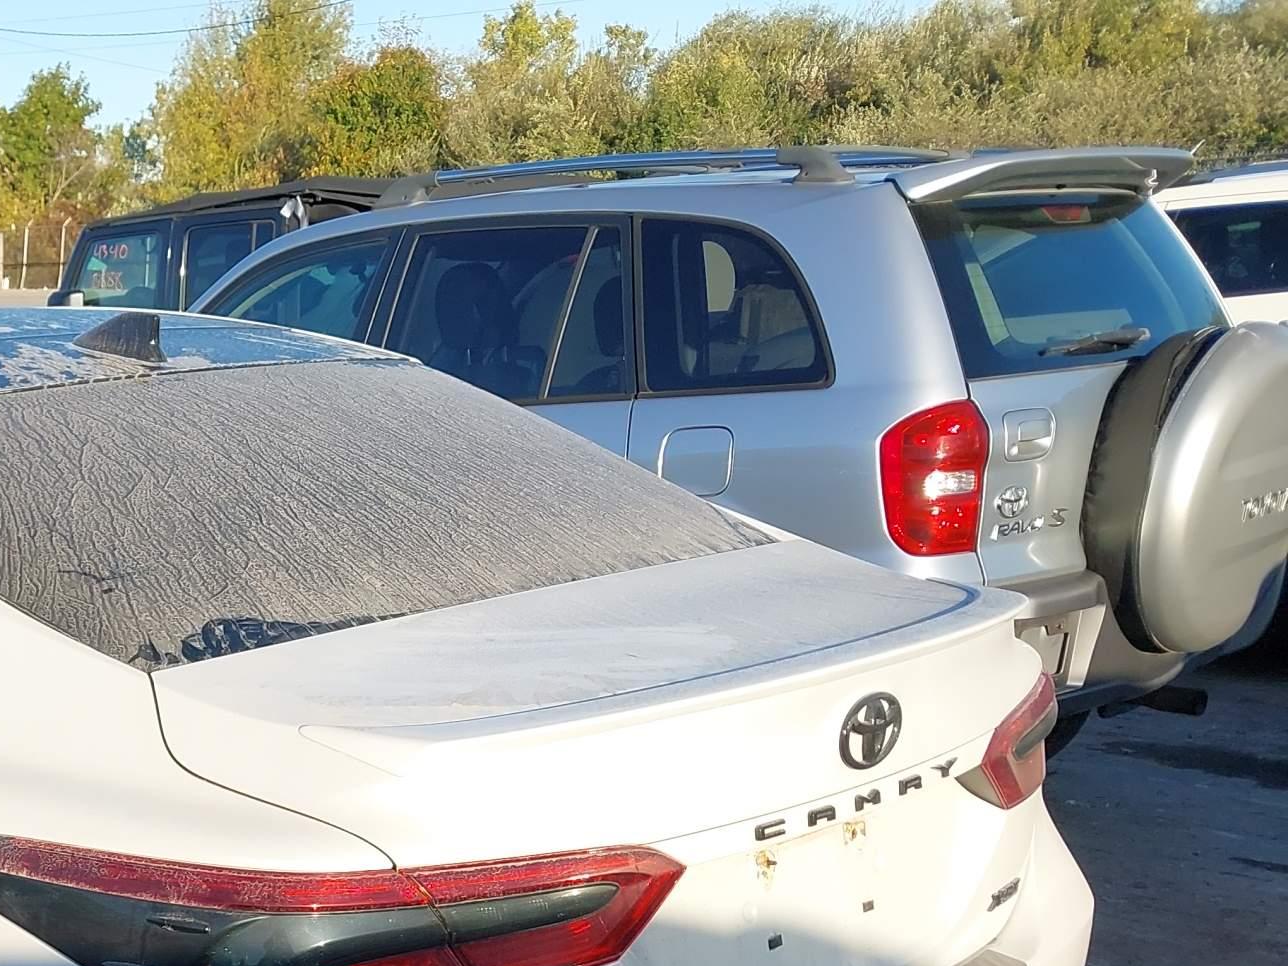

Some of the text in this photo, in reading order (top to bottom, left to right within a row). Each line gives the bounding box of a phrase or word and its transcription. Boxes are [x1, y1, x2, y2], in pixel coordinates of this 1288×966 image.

[93, 243, 129, 260] 4340
[1240, 489, 1288, 523] TOYOT
[754, 756, 958, 842] CAMRY
